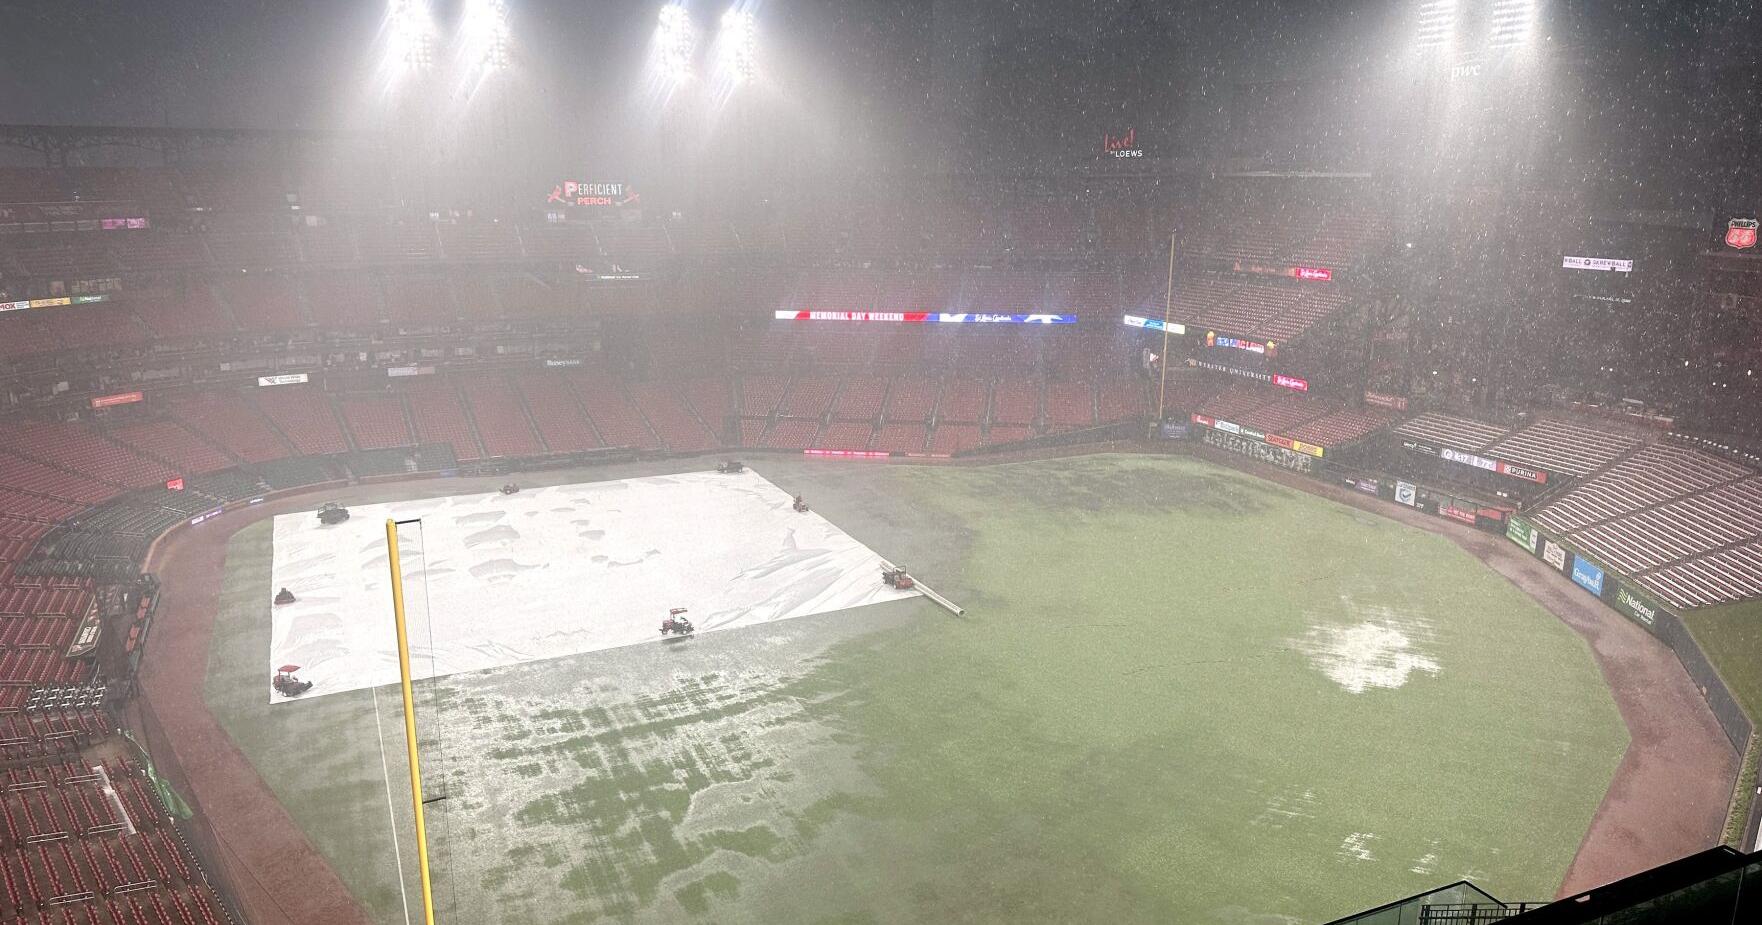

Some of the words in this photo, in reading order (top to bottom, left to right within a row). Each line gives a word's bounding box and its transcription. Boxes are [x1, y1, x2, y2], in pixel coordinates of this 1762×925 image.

[1451, 64, 1481, 80] pwc
[1115, 149, 1143, 158] LOEWS
[563, 181, 623, 198] PERFICIENT
[577, 197, 612, 205] PERCH
[1731, 220, 1756, 228] PHILLIPS
[809, 311, 849, 320] MEMORIAL
[851, 312, 866, 320] DAY
[868, 312, 905, 321] WEEKEND
[1229, 369, 1272, 382] UNIVERSITY
[1510, 466, 1536, 479] PURINA
[1626, 594, 1656, 620] National
